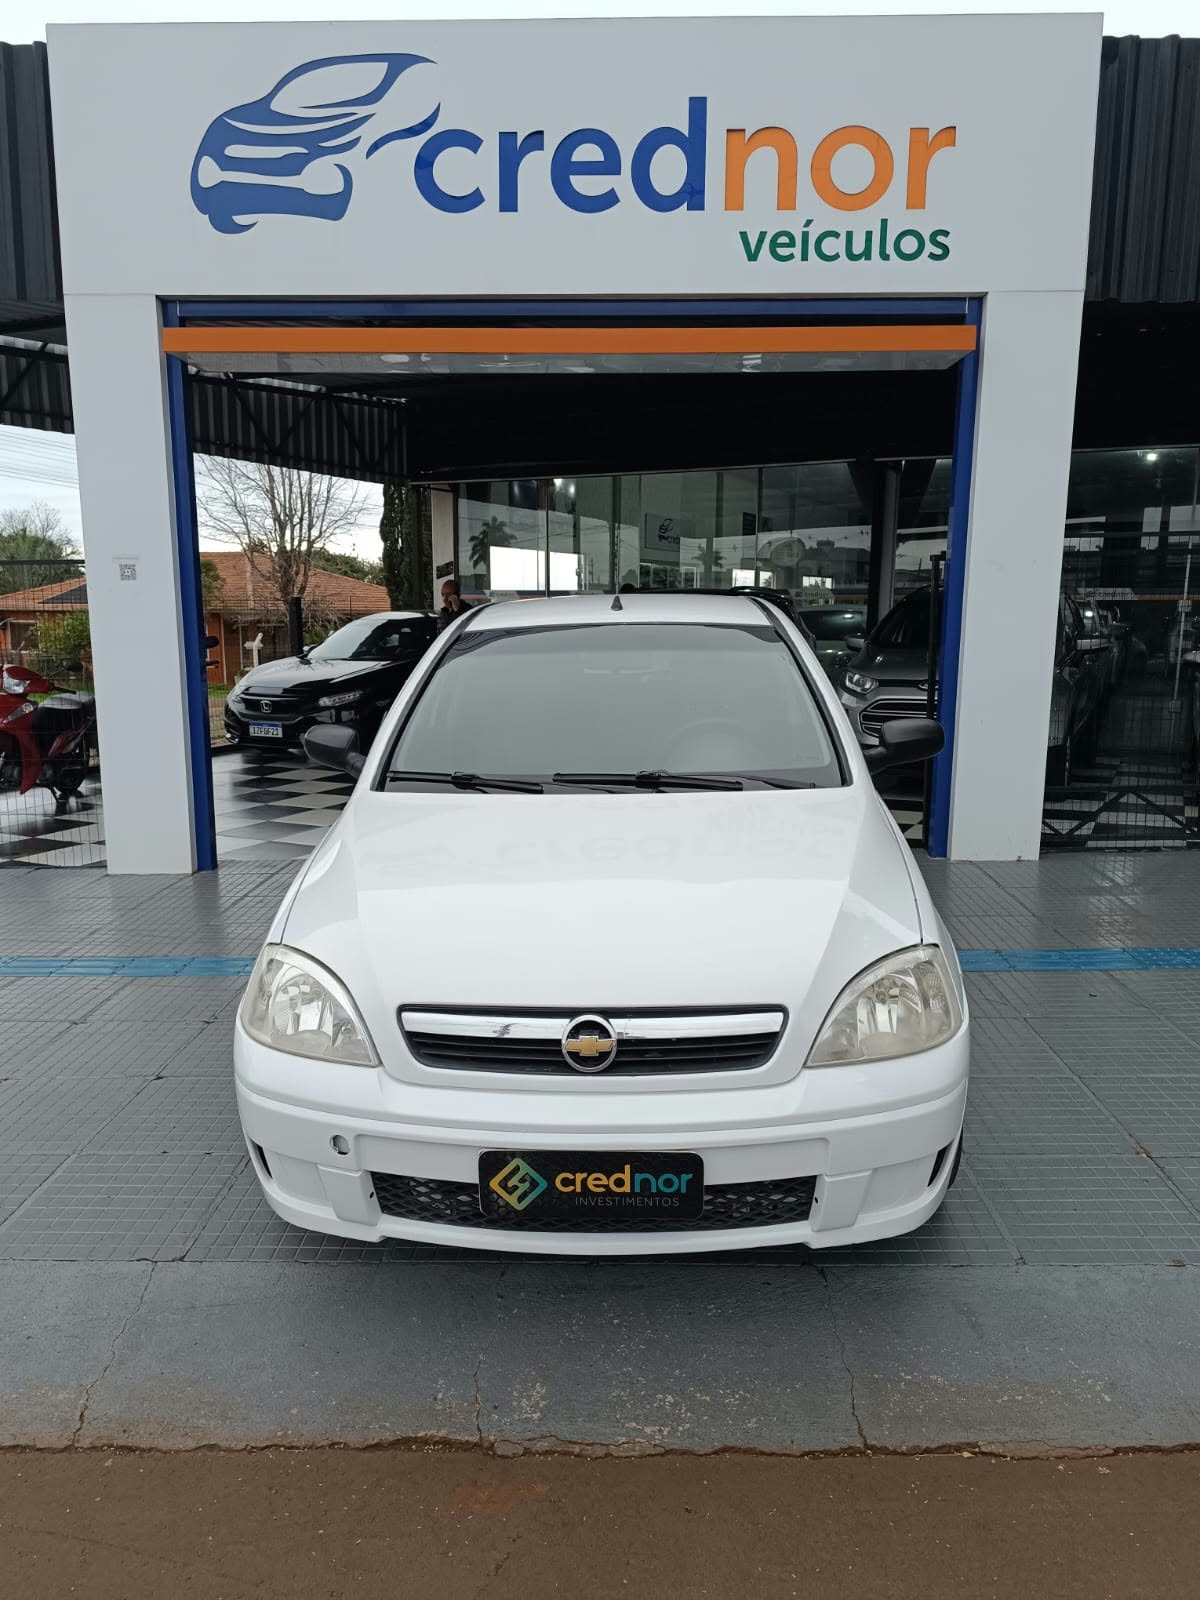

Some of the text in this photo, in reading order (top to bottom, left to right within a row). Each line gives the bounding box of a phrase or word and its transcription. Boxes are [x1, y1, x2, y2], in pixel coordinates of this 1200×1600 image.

[413, 96, 957, 214] crednor
[738, 218, 951, 263] veículos
[554, 1164, 693, 1194] crednor
[574, 1196, 680, 1207] INVESTIMENTOS
